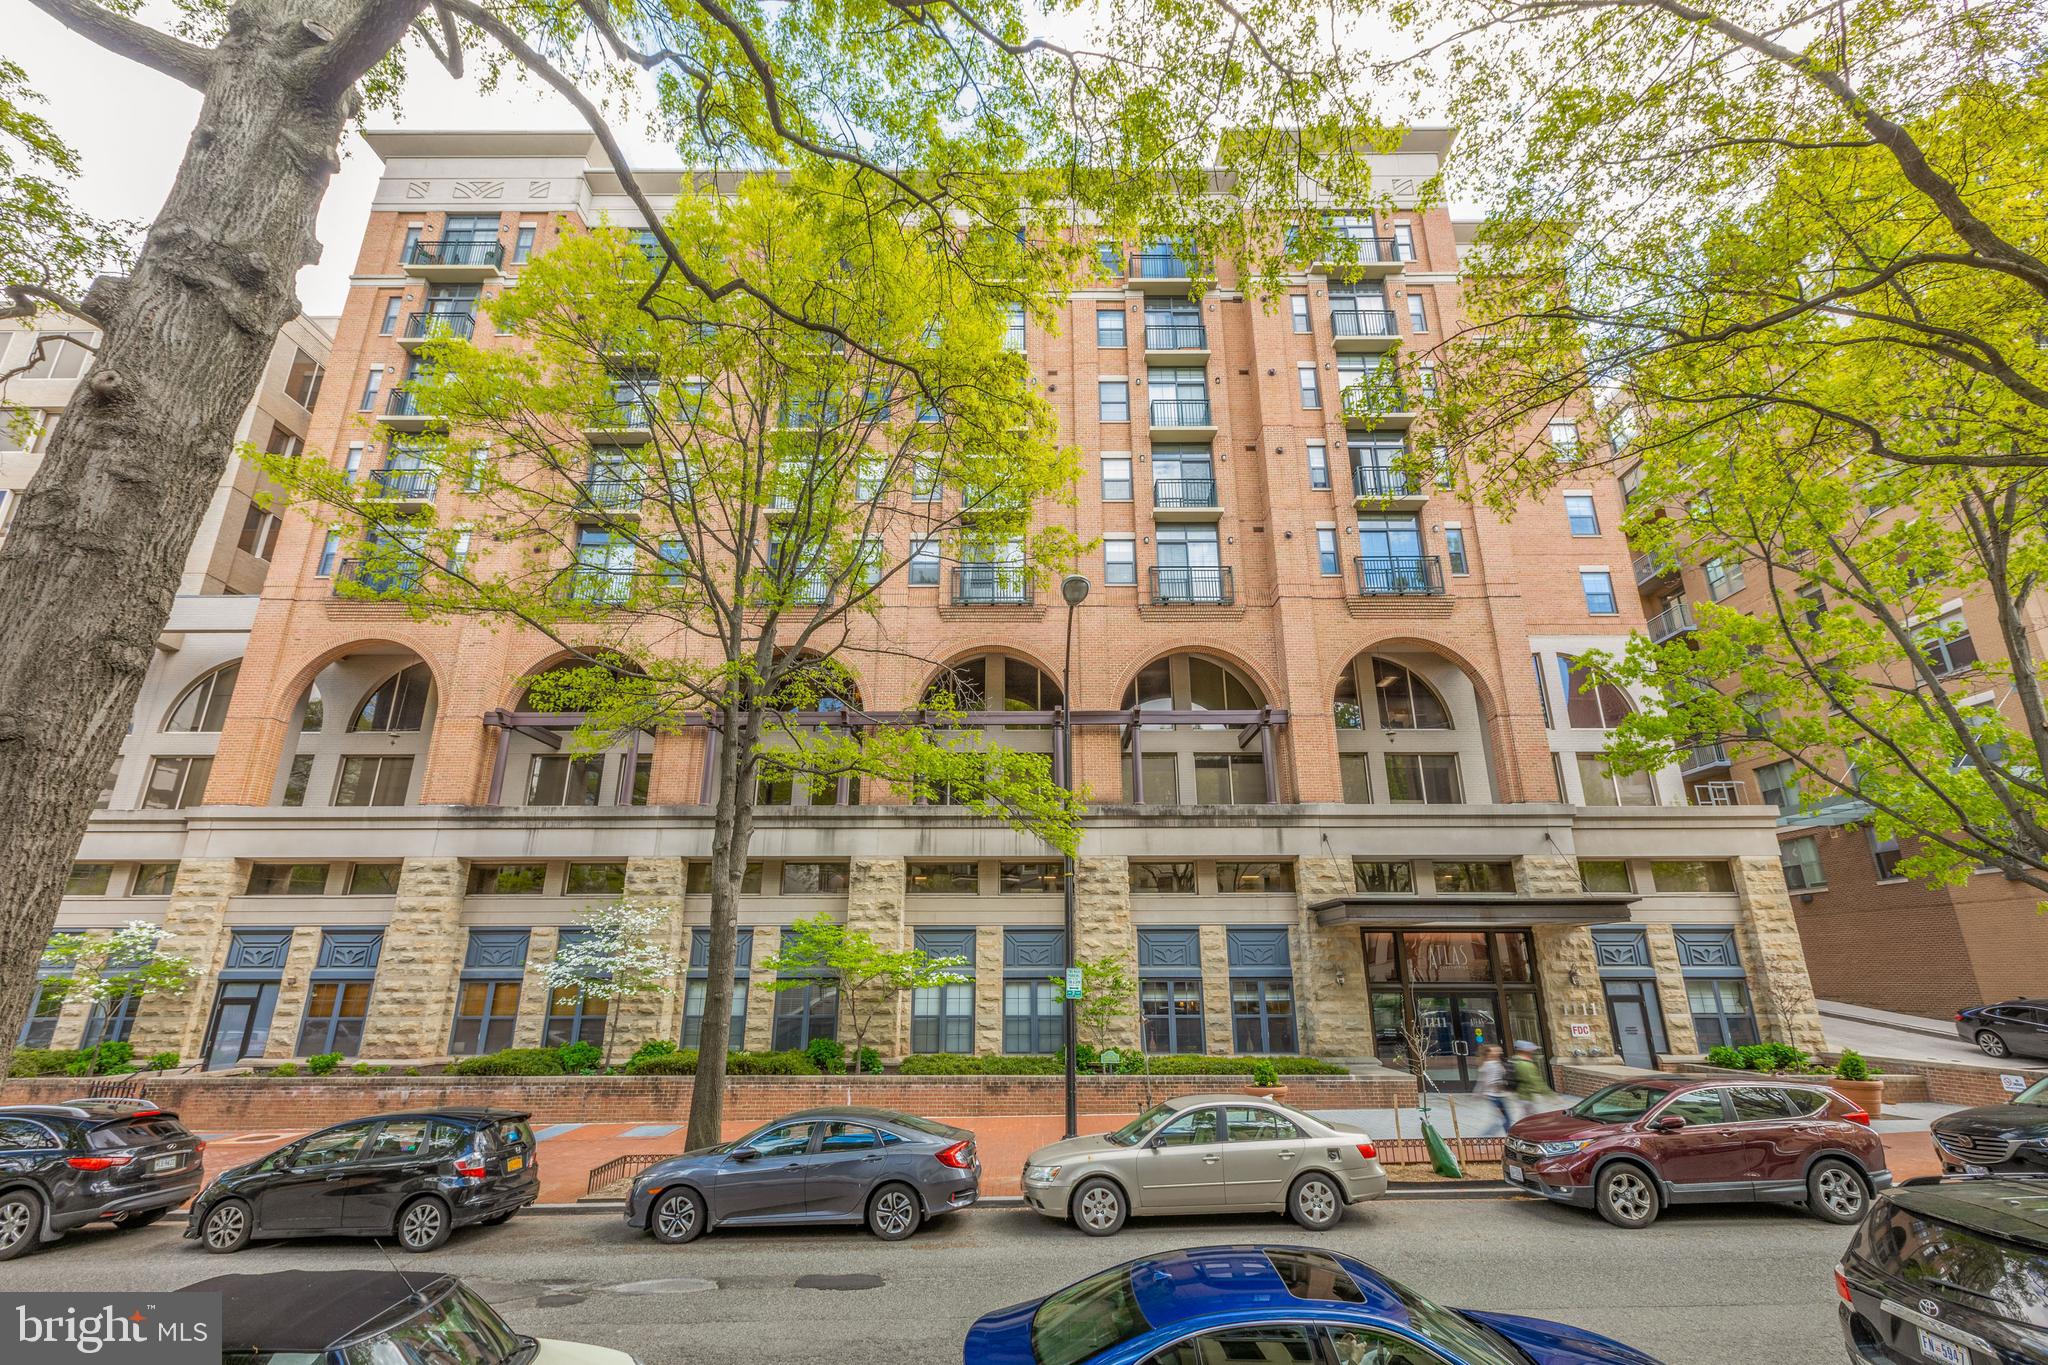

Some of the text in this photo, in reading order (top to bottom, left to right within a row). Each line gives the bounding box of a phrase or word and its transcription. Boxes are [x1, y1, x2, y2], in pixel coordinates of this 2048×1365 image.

[1428, 944, 1468, 969] ATLAS
[1562, 1002, 1598, 1016] 1111
[1572, 1025, 1589, 1035] FDC
